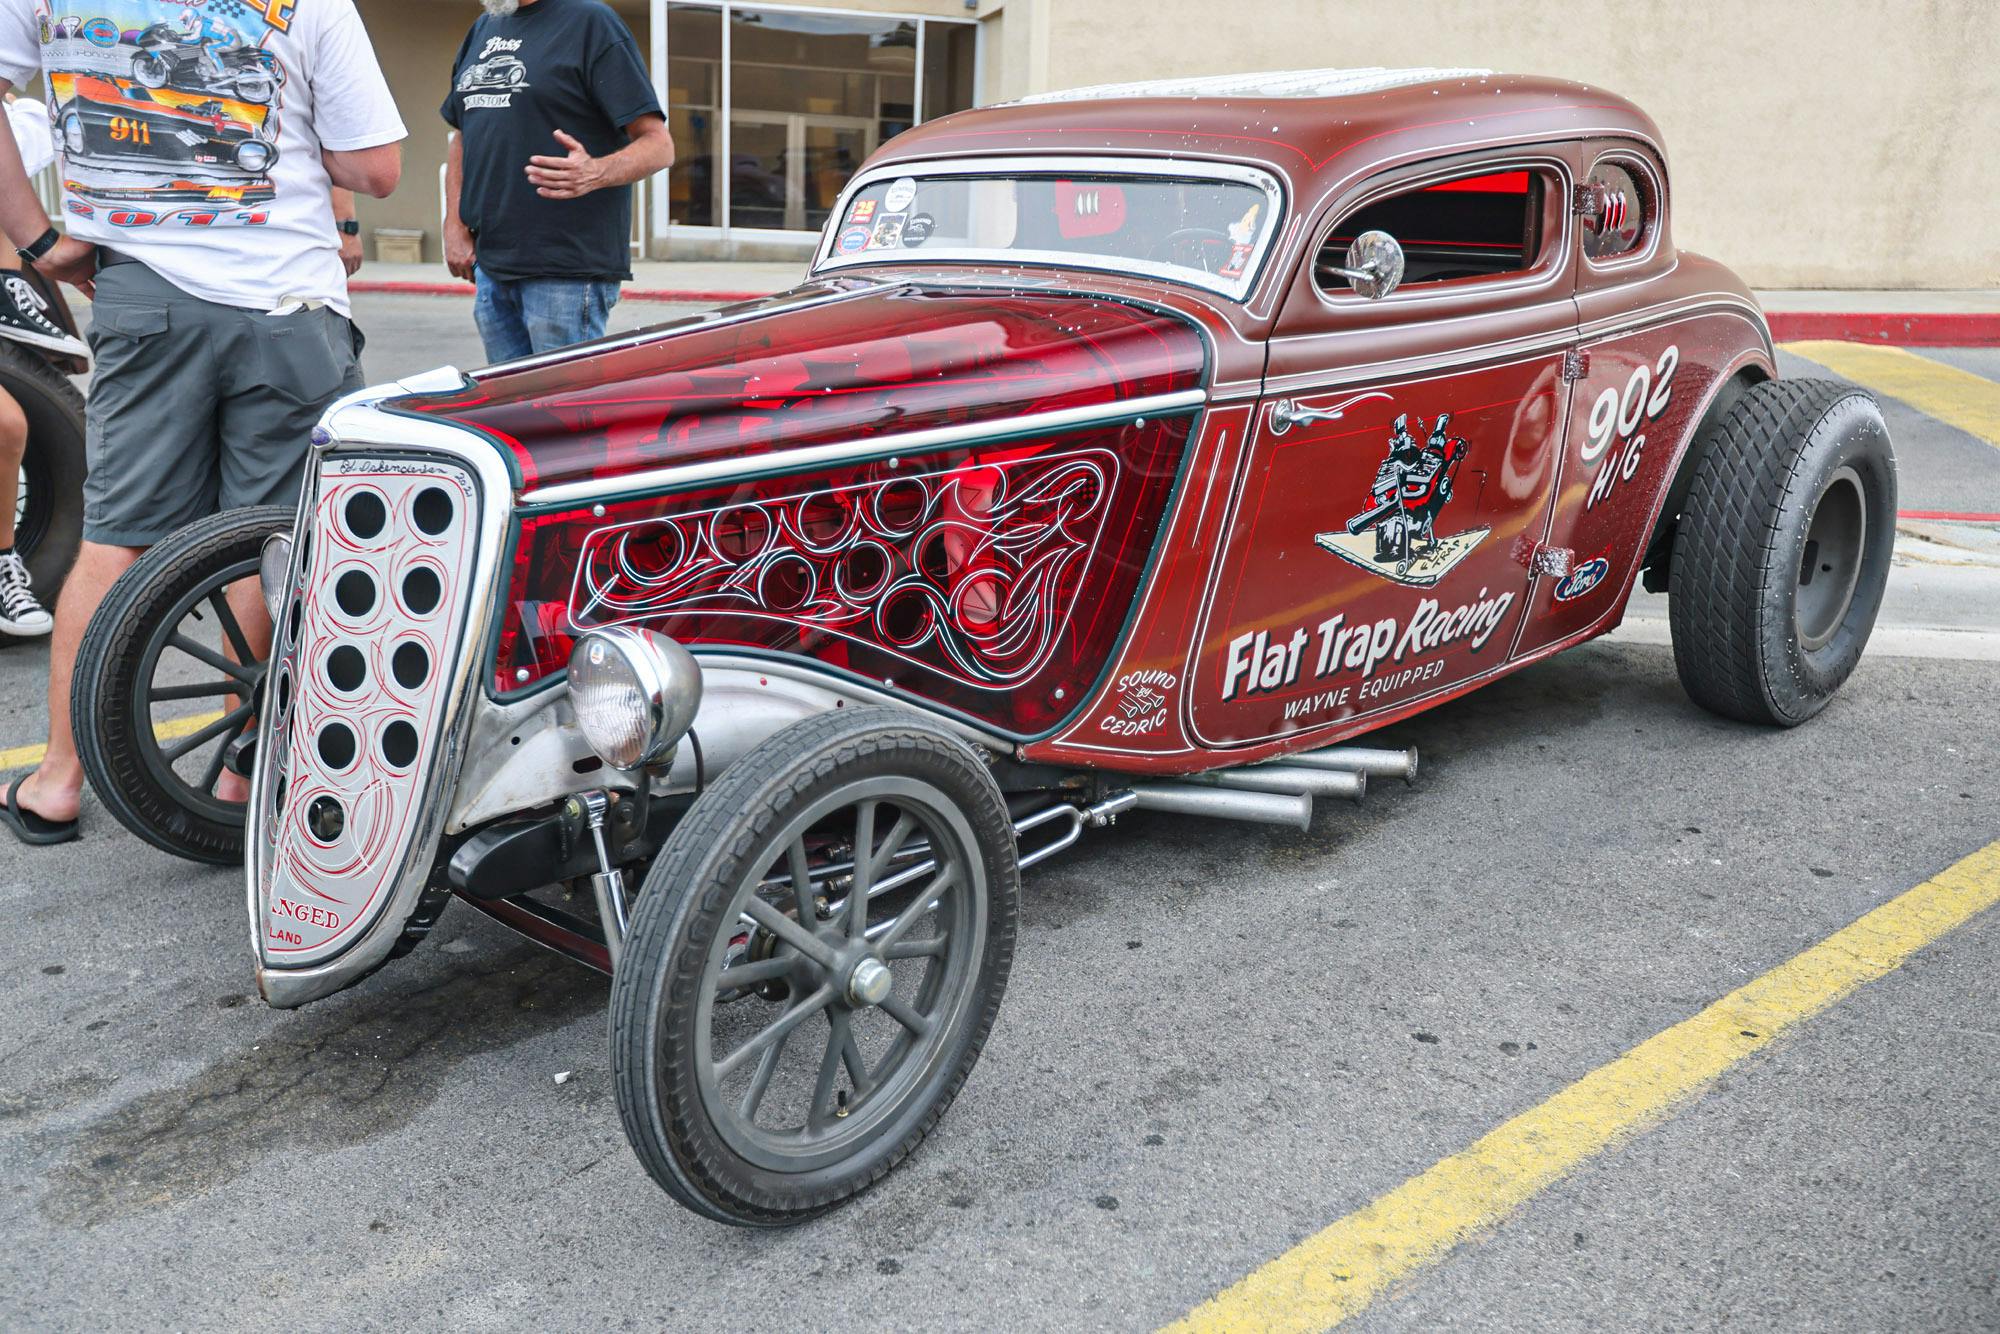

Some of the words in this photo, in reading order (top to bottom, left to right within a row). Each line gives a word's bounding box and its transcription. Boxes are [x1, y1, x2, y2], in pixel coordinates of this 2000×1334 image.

[110, 116, 151, 145] 911
[67, 199, 270, 227] 2011
[1580, 344, 1680, 461] 902
[1587, 433, 1647, 511] H/G
[1432, 540, 1460, 569] TRAP
[1562, 560, 1602, 597] Ford
[1222, 627, 1309, 701] Flat
[1314, 613, 1397, 679] Trap
[1393, 586, 1516, 657] Racing
[1116, 669, 1177, 692] SOUND
[1283, 686, 1351, 720] WAYNE
[1358, 658, 1445, 701] EQUIPPED
[1100, 708, 1167, 736] CEDRIC
[271, 897, 341, 930] NGED
